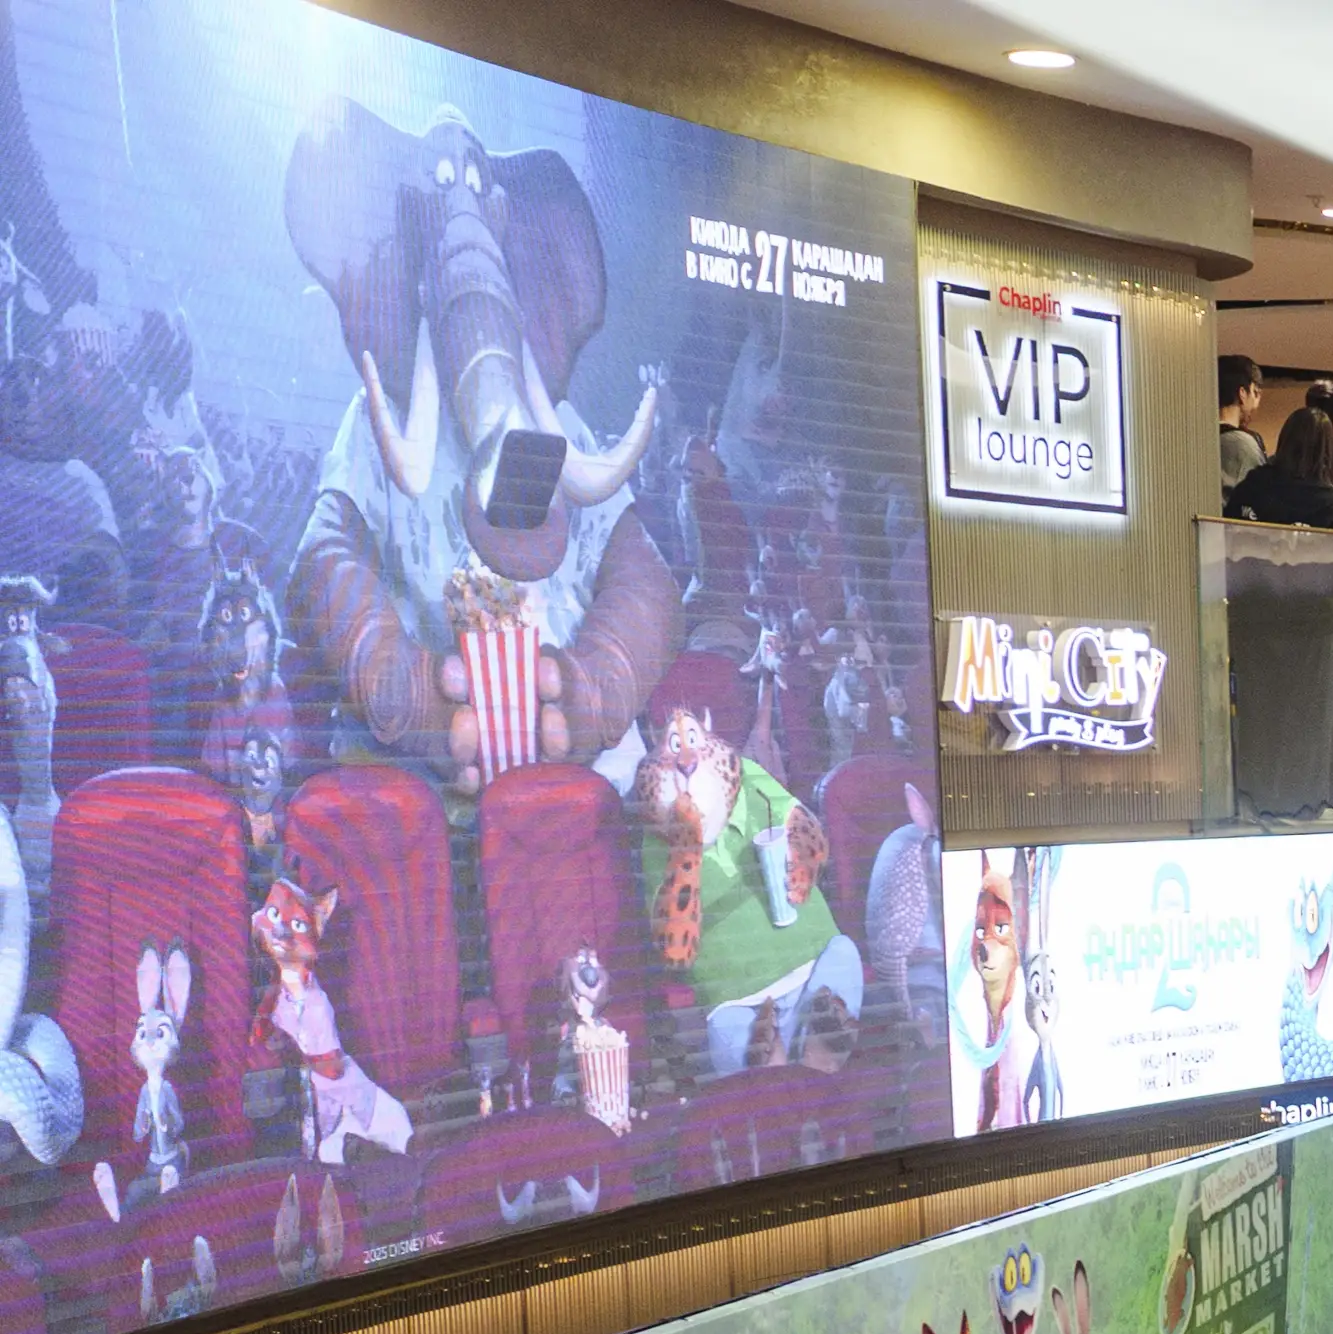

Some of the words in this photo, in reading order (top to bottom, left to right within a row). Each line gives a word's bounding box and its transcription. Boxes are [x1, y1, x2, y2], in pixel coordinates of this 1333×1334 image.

[686, 250, 697, 279] В
[699, 253, 739, 289] КИНО
[793, 271, 846, 307] НОЯБРЯ
[690, 216, 750, 255] КИНОДА
[755, 230, 788, 295] 27
[999, 286, 1063, 316] Chaplin
[974, 329, 1091, 424] VIP
[977, 417, 1094, 480] lounge
[389, 1236, 425, 1257] DISNEY
[1201, 1180, 1284, 1296] MARSH
[1196, 1251, 1284, 1328] MARKET
